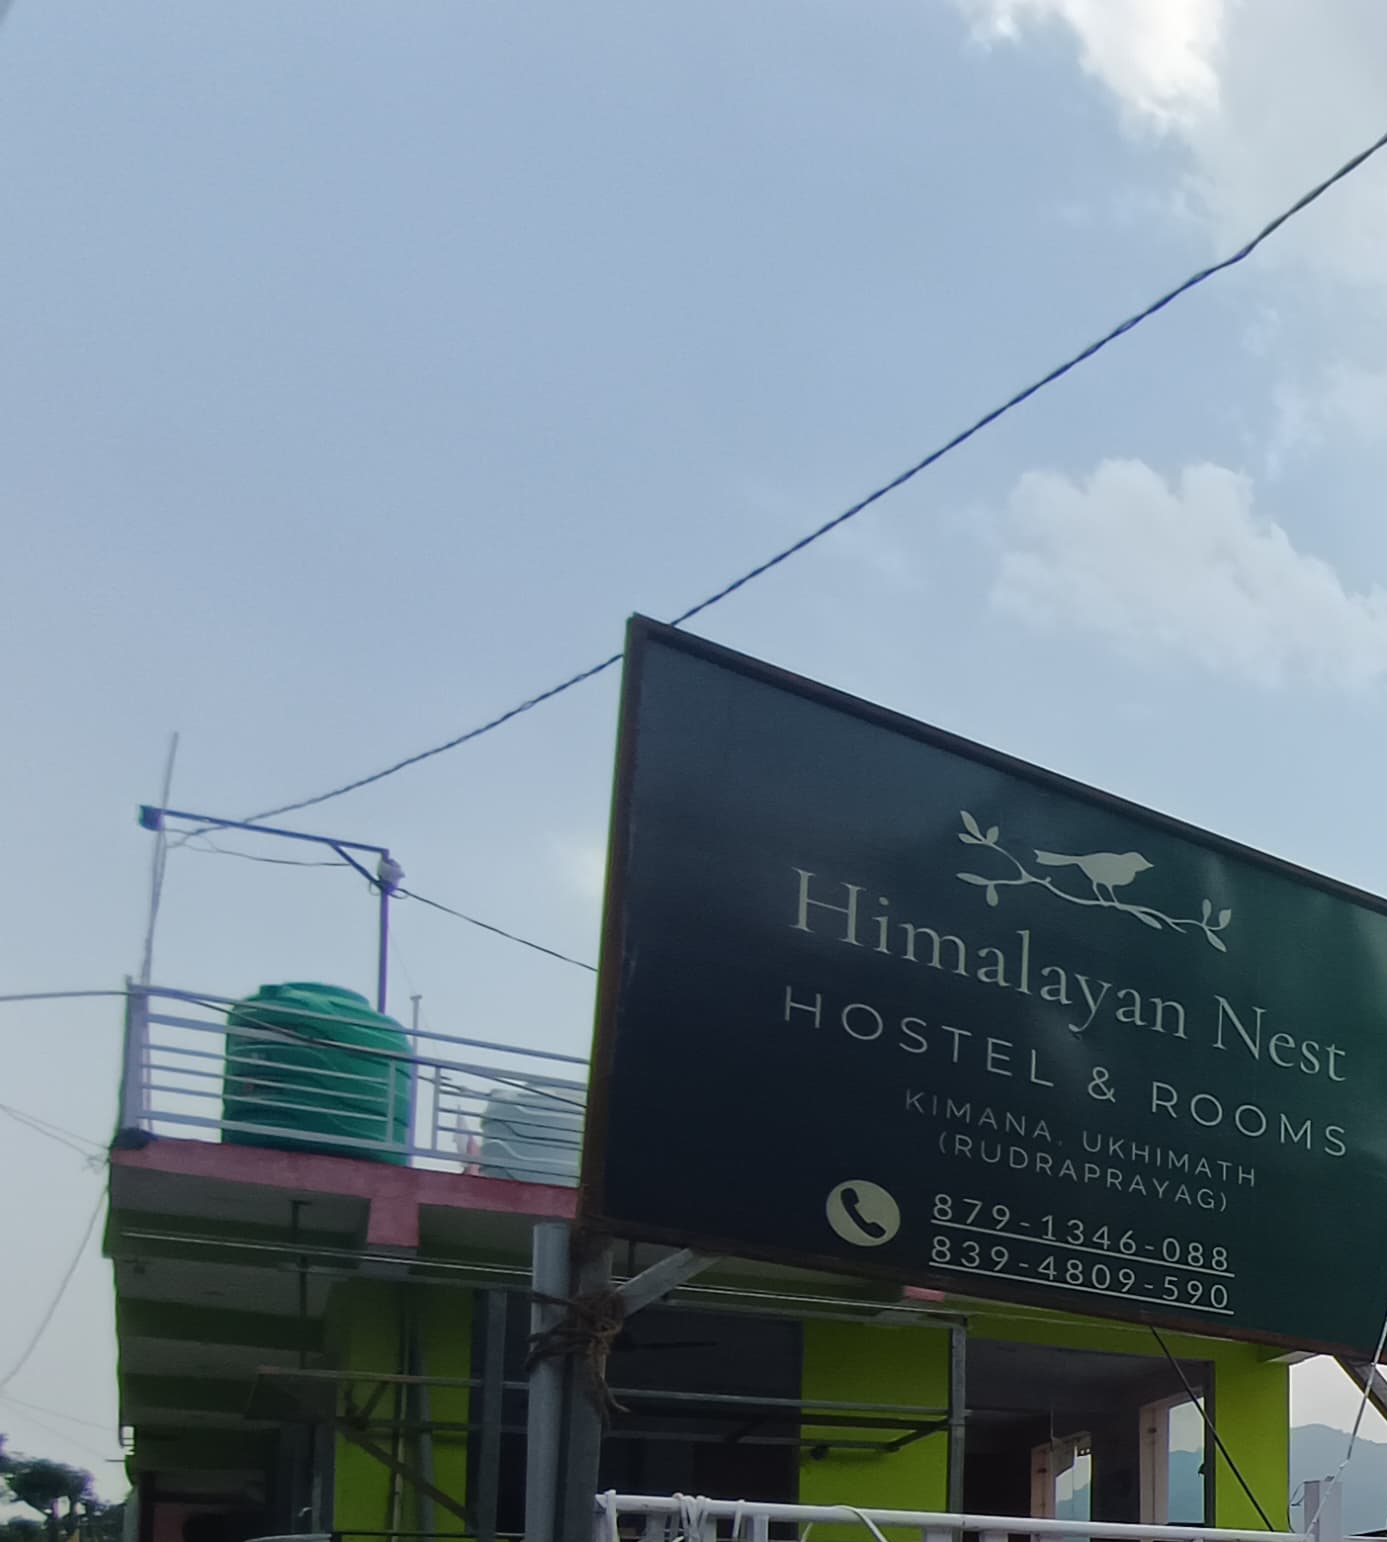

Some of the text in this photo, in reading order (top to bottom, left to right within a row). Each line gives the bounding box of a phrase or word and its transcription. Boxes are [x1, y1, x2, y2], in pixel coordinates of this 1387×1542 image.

[788, 866, 1348, 1082] Himalayan Nest
[784, 985, 1347, 1156] HOSTEL & ROOMS
[938, 1130, 1228, 1213] (RUDRAPRAYAG)
[1082, 1130, 1256, 1188] UKHIMATH
[931, 1234, 1229, 1309] 839-4809-590
[932, 1193, 1229, 1272] 879-1346-088
